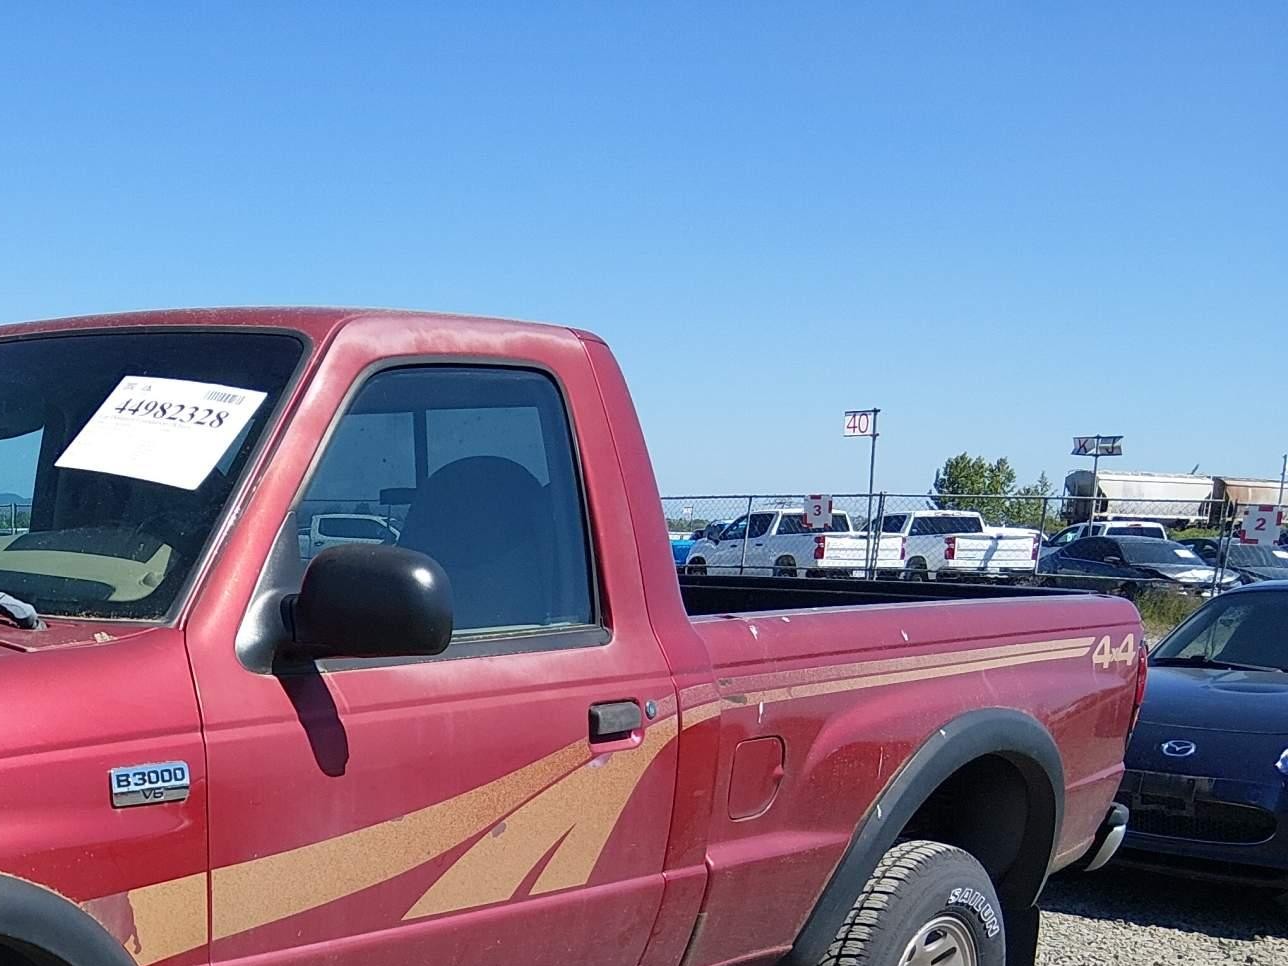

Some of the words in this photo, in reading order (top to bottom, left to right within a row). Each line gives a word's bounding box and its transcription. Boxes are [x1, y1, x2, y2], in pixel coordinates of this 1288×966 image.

[114, 398, 229, 429] 44982328
[847, 413, 869, 433] 40
[1076, 438, 1089, 454] K
[1105, 438, 1116, 454] J
[813, 505, 822, 516] 3
[1254, 518, 1266, 531] 2
[1092, 632, 1137, 669] 4x4
[115, 767, 185, 788] B3000
[141, 788, 164, 800] V6
[947, 887, 1000, 938] SAILUN
